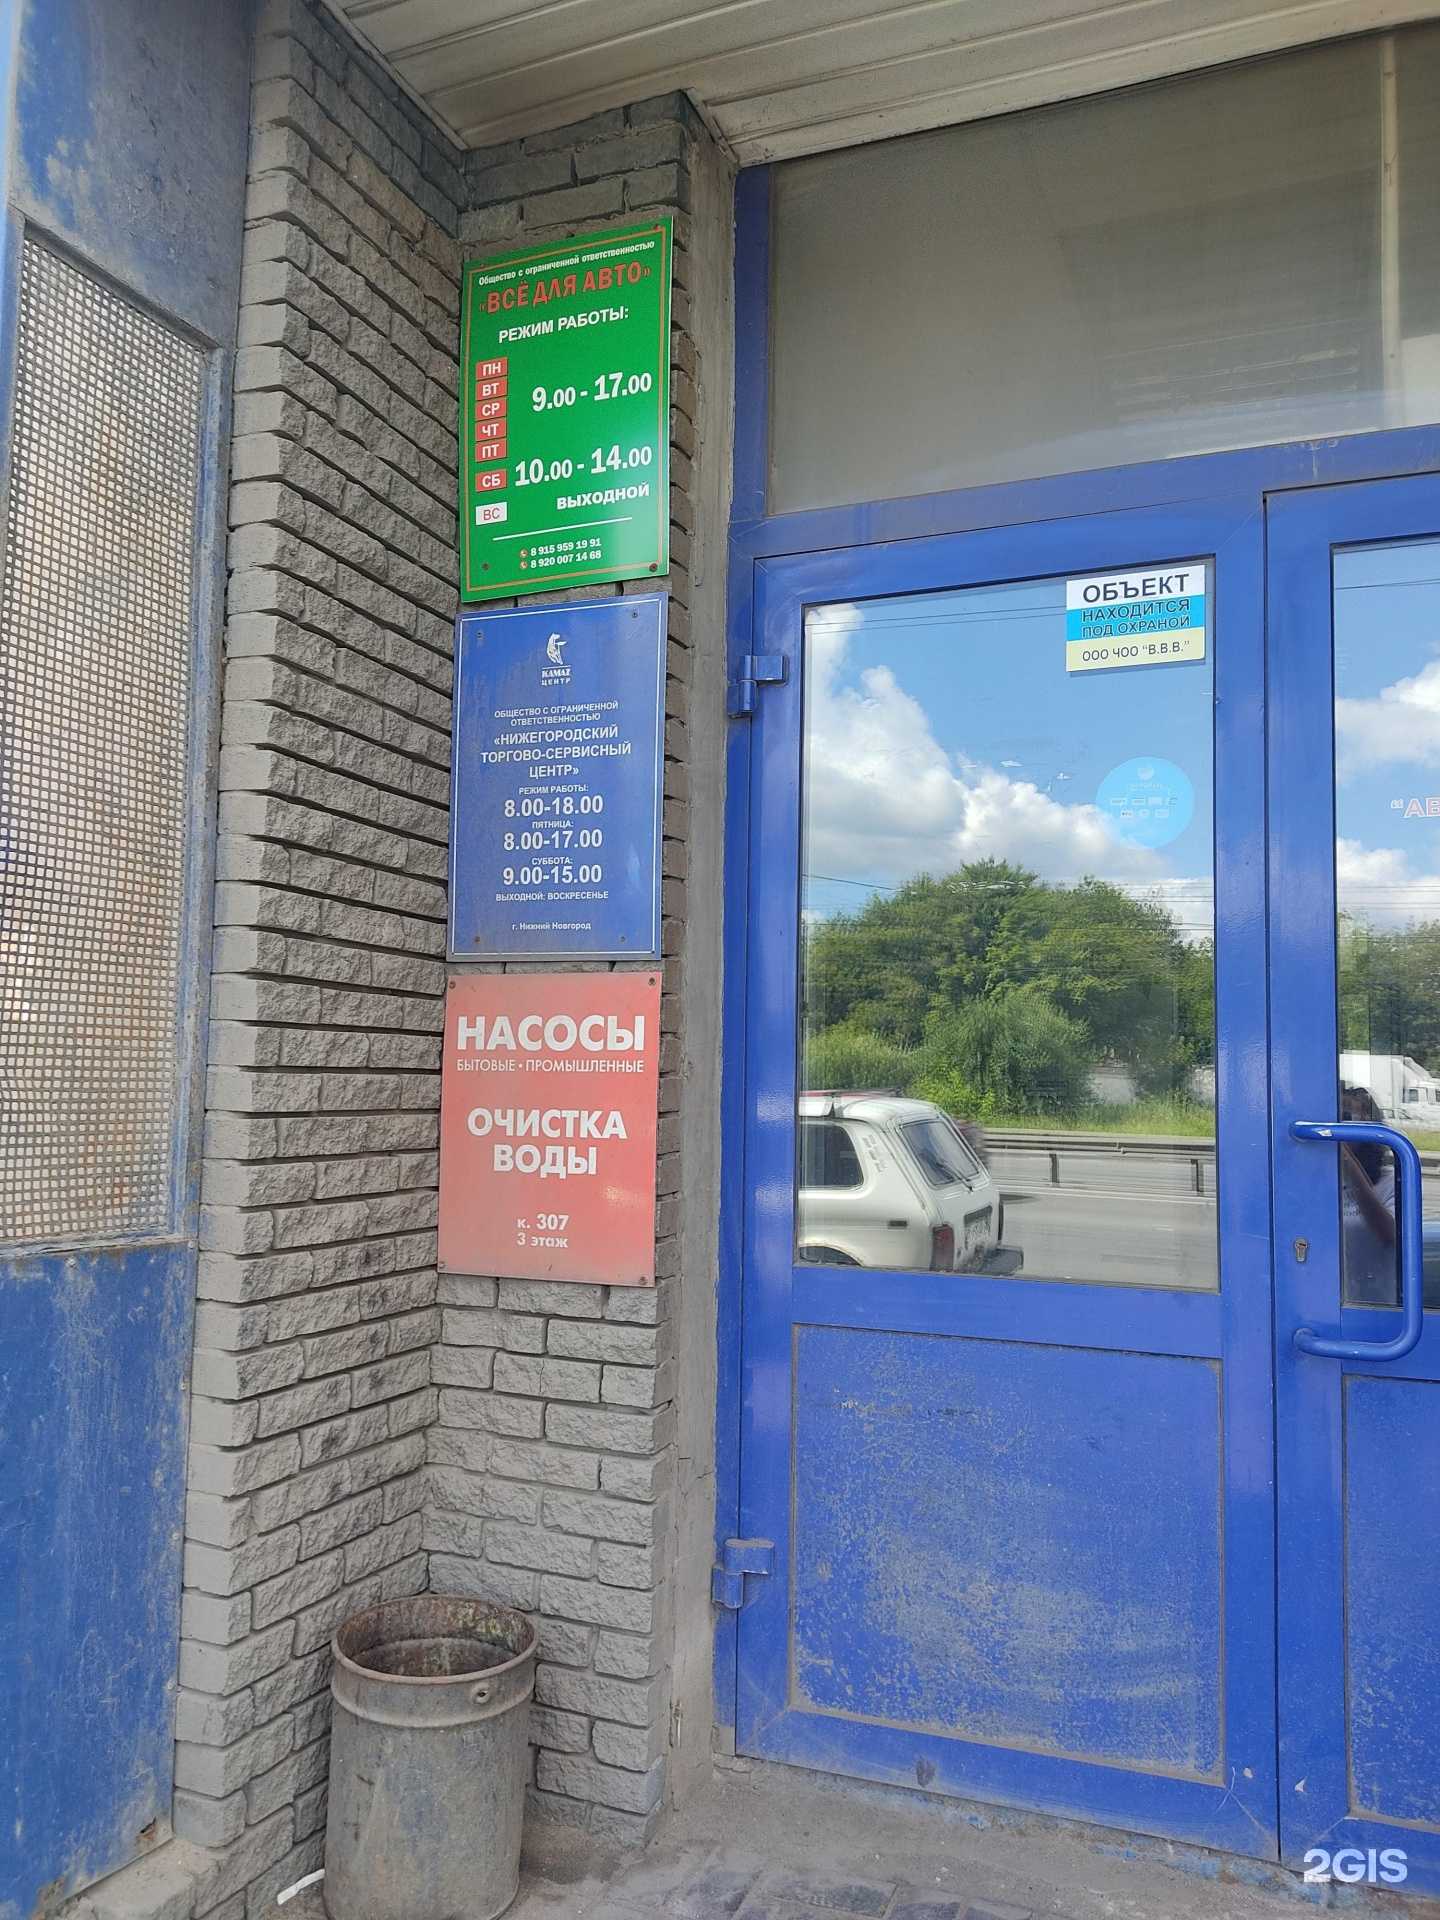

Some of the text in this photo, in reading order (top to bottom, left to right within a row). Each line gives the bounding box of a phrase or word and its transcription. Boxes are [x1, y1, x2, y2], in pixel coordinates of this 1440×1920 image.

[479, 240, 655, 286] Общество с ограниченной ответственностью
[480, 261, 650, 314] «ВСЁ ДЛЯ АВТО»
[498, 306, 629, 344] РЕЖИМ РАБОТЫ:
[482, 362, 502, 376] ПН
[482, 382, 500, 396] ВТ
[532, 386, 576, 412] 9.00
[594, 372, 652, 401] 17.00
[482, 402, 500, 417] СР
[482, 423, 500, 438] ЧТ
[482, 444, 500, 458] ПТ
[515, 458, 572, 486] 10.00
[591, 445, 652, 474] 14.00
[482, 474, 501, 488] СБ
[483, 508, 500, 521] ВС
[530, 538, 602, 556] 8 915 959 19 91
[530, 550, 602, 568] 8 920 007 14 68
[1083, 574, 1189, 603] ОБЪЕКТ
[1082, 599, 1190, 622] НАХОДИТСЯ
[1082, 624, 1114, 638] ПОД
[1082, 649, 1108, 662] ООО
[1112, 646, 1138, 658] ЧОО
[542, 678, 570, 687] ЦЕНТР
[494, 701, 618, 720] ОБЩЕСТВО С ОГРАНИЧЕННОЙ
[510, 712, 600, 726] ОТВЕТСТВЕННОСТЬЮ
[494, 726, 618, 746] «НИЖЕГОРОДСКИЙ
[480, 742, 632, 764] ТОРГОВО-СЕРВИСНЫЙ
[529, 764, 579, 780] ЦЕНТР»
[518, 784, 589, 796] РЕЖИМ РАБОТЫ:
[504, 795, 604, 818] 8.00-18.00
[532, 820, 574, 829] ПЯТНИЦА:
[504, 829, 602, 850] 8.00-17.00
[532, 857, 573, 866] СУББОТА:
[503, 864, 602, 886] 9.00-15.00
[496, 890, 608, 902] ВЫХОДНОЙ: ВОСКРЕСЕНЬЕ
[520, 922, 550, 930] Нижний
[552, 922, 591, 930] Новгород
[457, 1015, 645, 1052] НАСОСЫ
[457, 1059, 644, 1073] БЫТОВЫЕ ПРОМЫШЛЕННЫЕ
[467, 1108, 628, 1139] ОЧИСТКА
[493, 1145, 597, 1179] ВОДЫ
[517, 1214, 570, 1230] к. 307
[517, 1233, 568, 1248] 3 этаж
